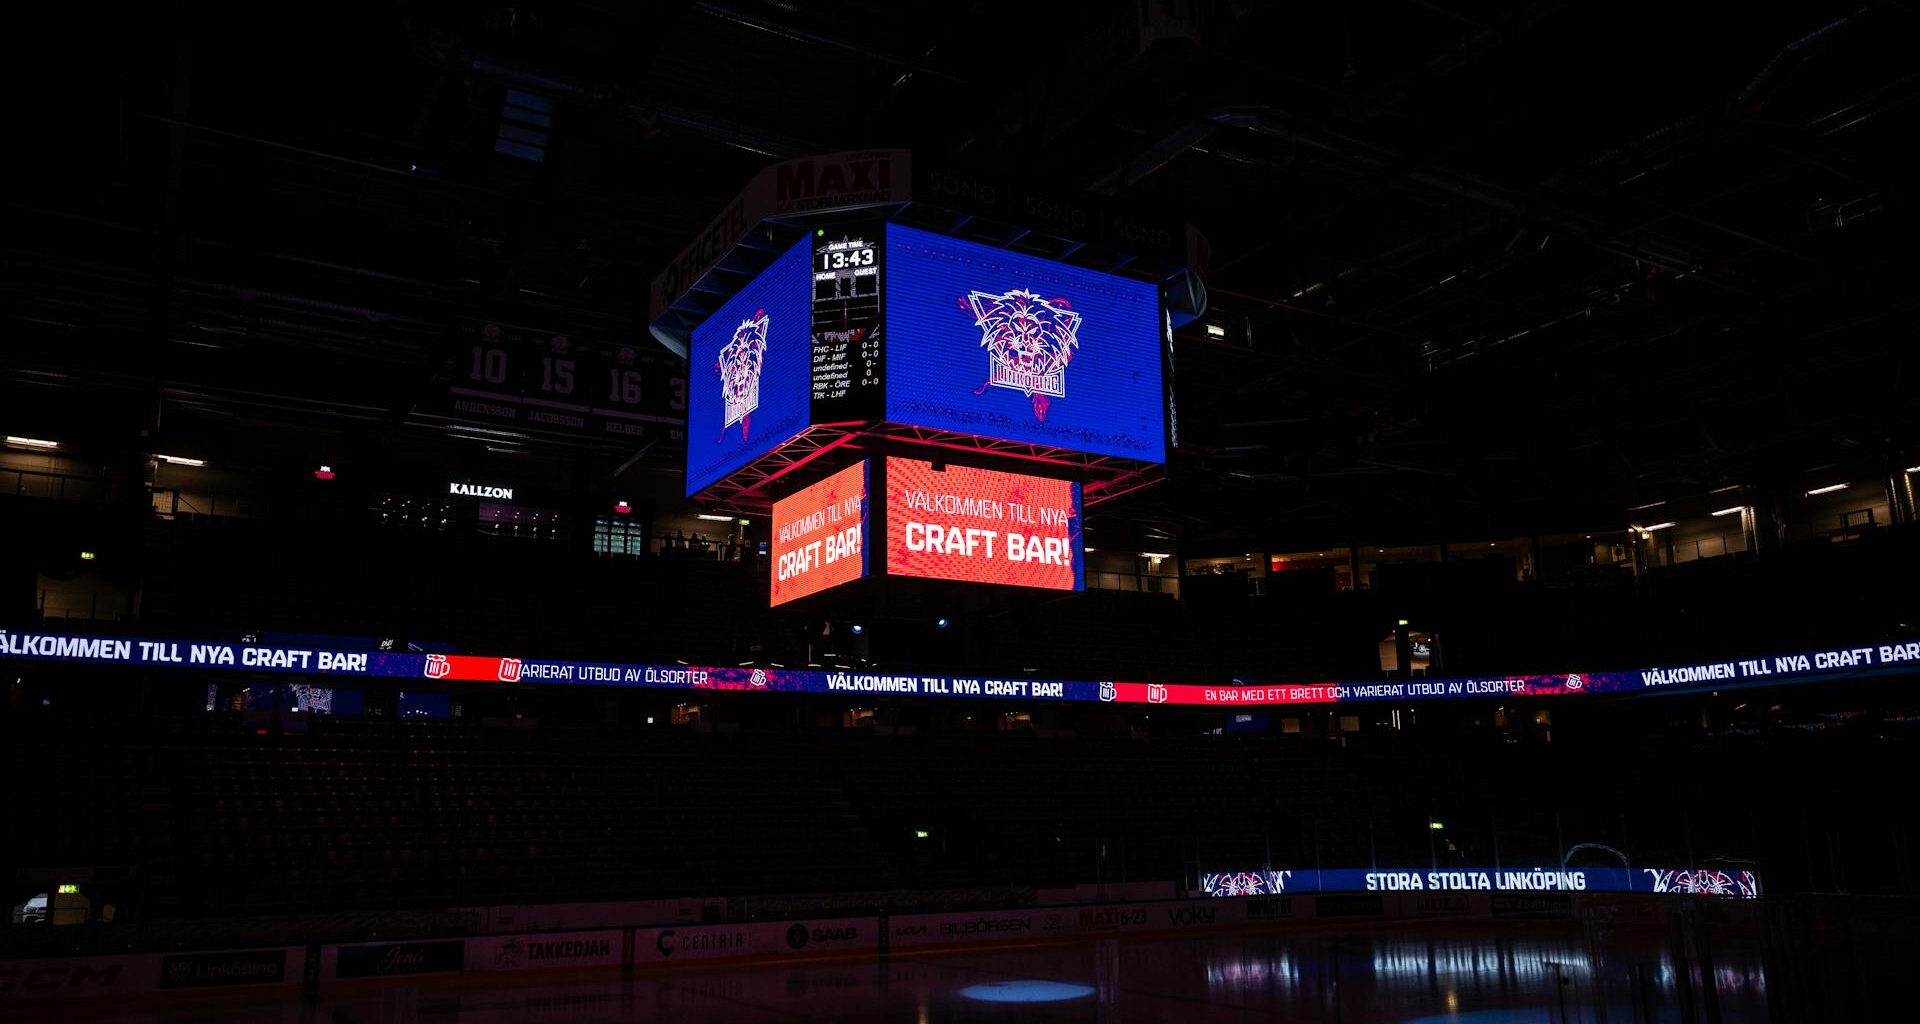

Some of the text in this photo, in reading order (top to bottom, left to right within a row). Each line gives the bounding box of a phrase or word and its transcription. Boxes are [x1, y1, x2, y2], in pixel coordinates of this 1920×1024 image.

[777, 160, 890, 202] MAXI
[1024, 193, 1088, 228] SONO
[1112, 215, 1172, 249] SONO
[828, 240, 864, 251] GAME TIME
[824, 248, 874, 270] 13:43
[815, 267, 878, 281] HOME GUEST
[813, 345, 830, 354] FHC
[835, 343, 848, 352] LIF
[813, 354, 827, 363] DIF
[831, 352, 847, 362] MIF
[469, 345, 509, 385] 10
[540, 356, 577, 395] 15
[813, 362, 849, 372] undefined
[813, 371, 849, 381] undefined
[608, 367, 643, 406] 16
[813, 382, 829, 391] RBK
[831, 389, 847, 399] LHF
[453, 400, 517, 420] ANDERSSON
[527, 409, 585, 431] JACOBSSON
[449, 482, 513, 500] KALLZON
[905, 489, 1069, 527] VÄLKOMMEN TILL NYA
[779, 494, 862, 545] VÄLKOMMEN TILL NYA
[778, 523, 862, 582] CRAFT BAR!
[905, 522, 1070, 566] CRAFT BAR!
[138, 641, 183, 663] TILL
[190, 644, 234, 665] NYA
[241, 647, 312, 669] CRAFT
[317, 652, 367, 672] BAR!
[1641, 642, 1920, 687] VÄLKOMMEN TILL NYA CRAFT BAR
[517, 664, 708, 685] ARIERAT UTBUD AV ÖLSORTER
[826, 672, 1064, 698] VÄLKOMMEN TILL NYA CRAFT BAR!
[1205, 679, 1526, 701] EN BAR MED ETT BRETT OCH VARIERAT UTBUD AV ÖLSORTER
[1366, 867, 1586, 890] STORA STOLTA LINKÖPING
[812, 927, 857, 942] SAAB
[939, 917, 1031, 935] BILBÖRSEN
[527, 939, 610, 960] TAKKEDJAN
[196, 959, 278, 981] Linköping
